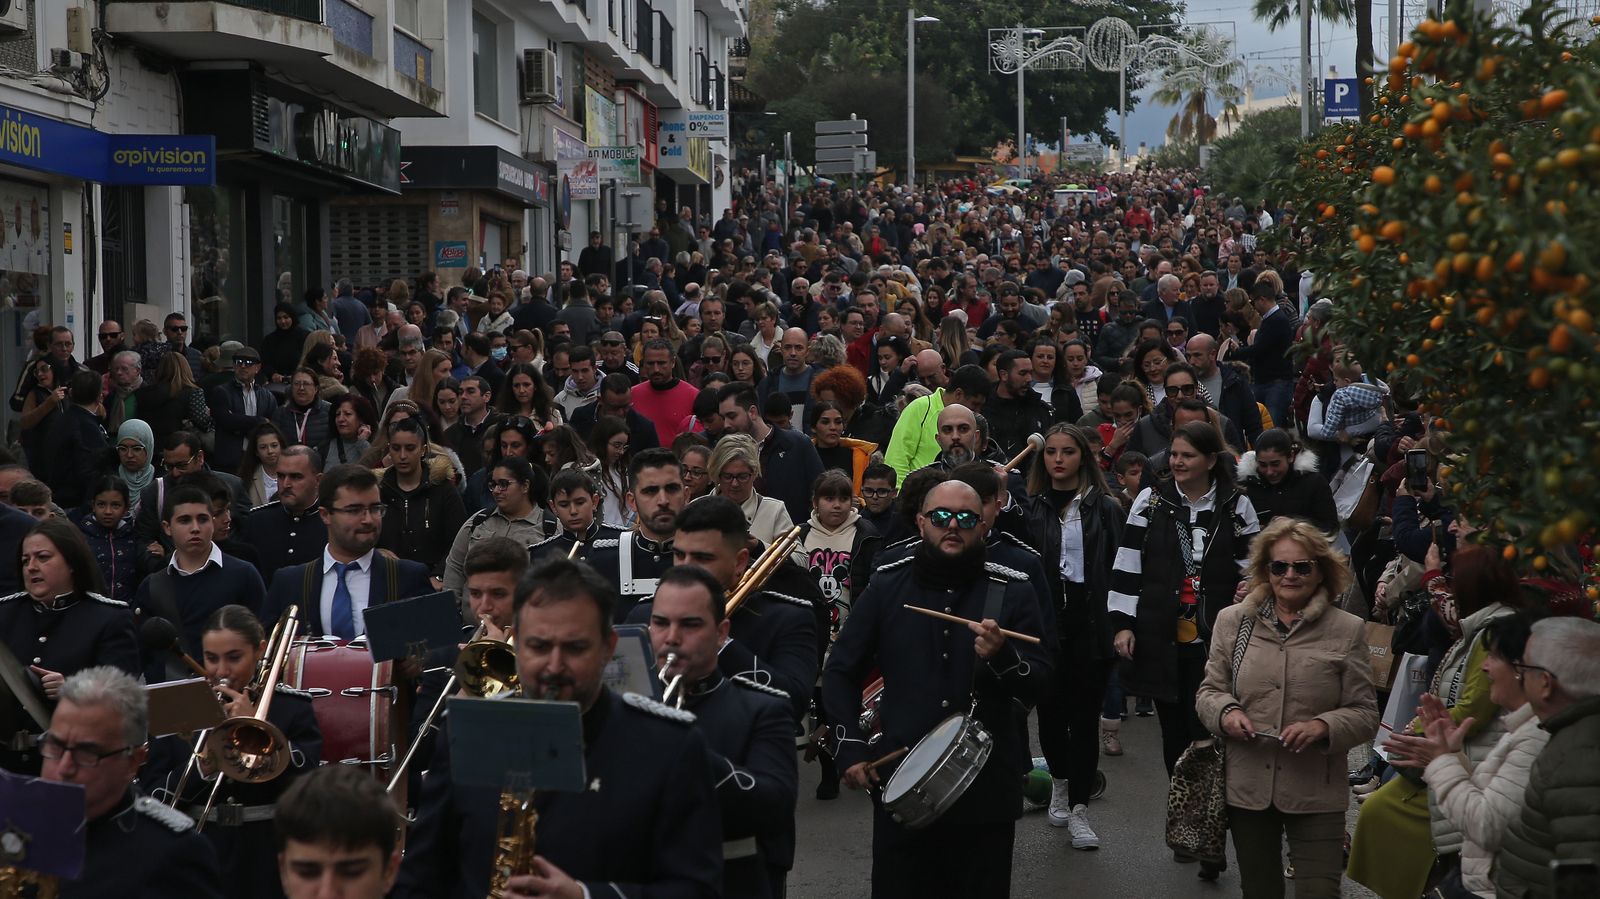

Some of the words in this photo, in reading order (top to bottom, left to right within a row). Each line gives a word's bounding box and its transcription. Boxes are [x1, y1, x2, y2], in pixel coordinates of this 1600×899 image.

[1335, 83, 1349, 103] P
[658, 121, 685, 131] Phone
[689, 121, 708, 131] 0%
[668, 134, 675, 143] &
[602, 150, 635, 159] MOBILE
[661, 145, 682, 156] Gold
[114, 147, 206, 167] opivision
[157, 166, 192, 174] queremos
[1368, 645, 1388, 655] yoral
